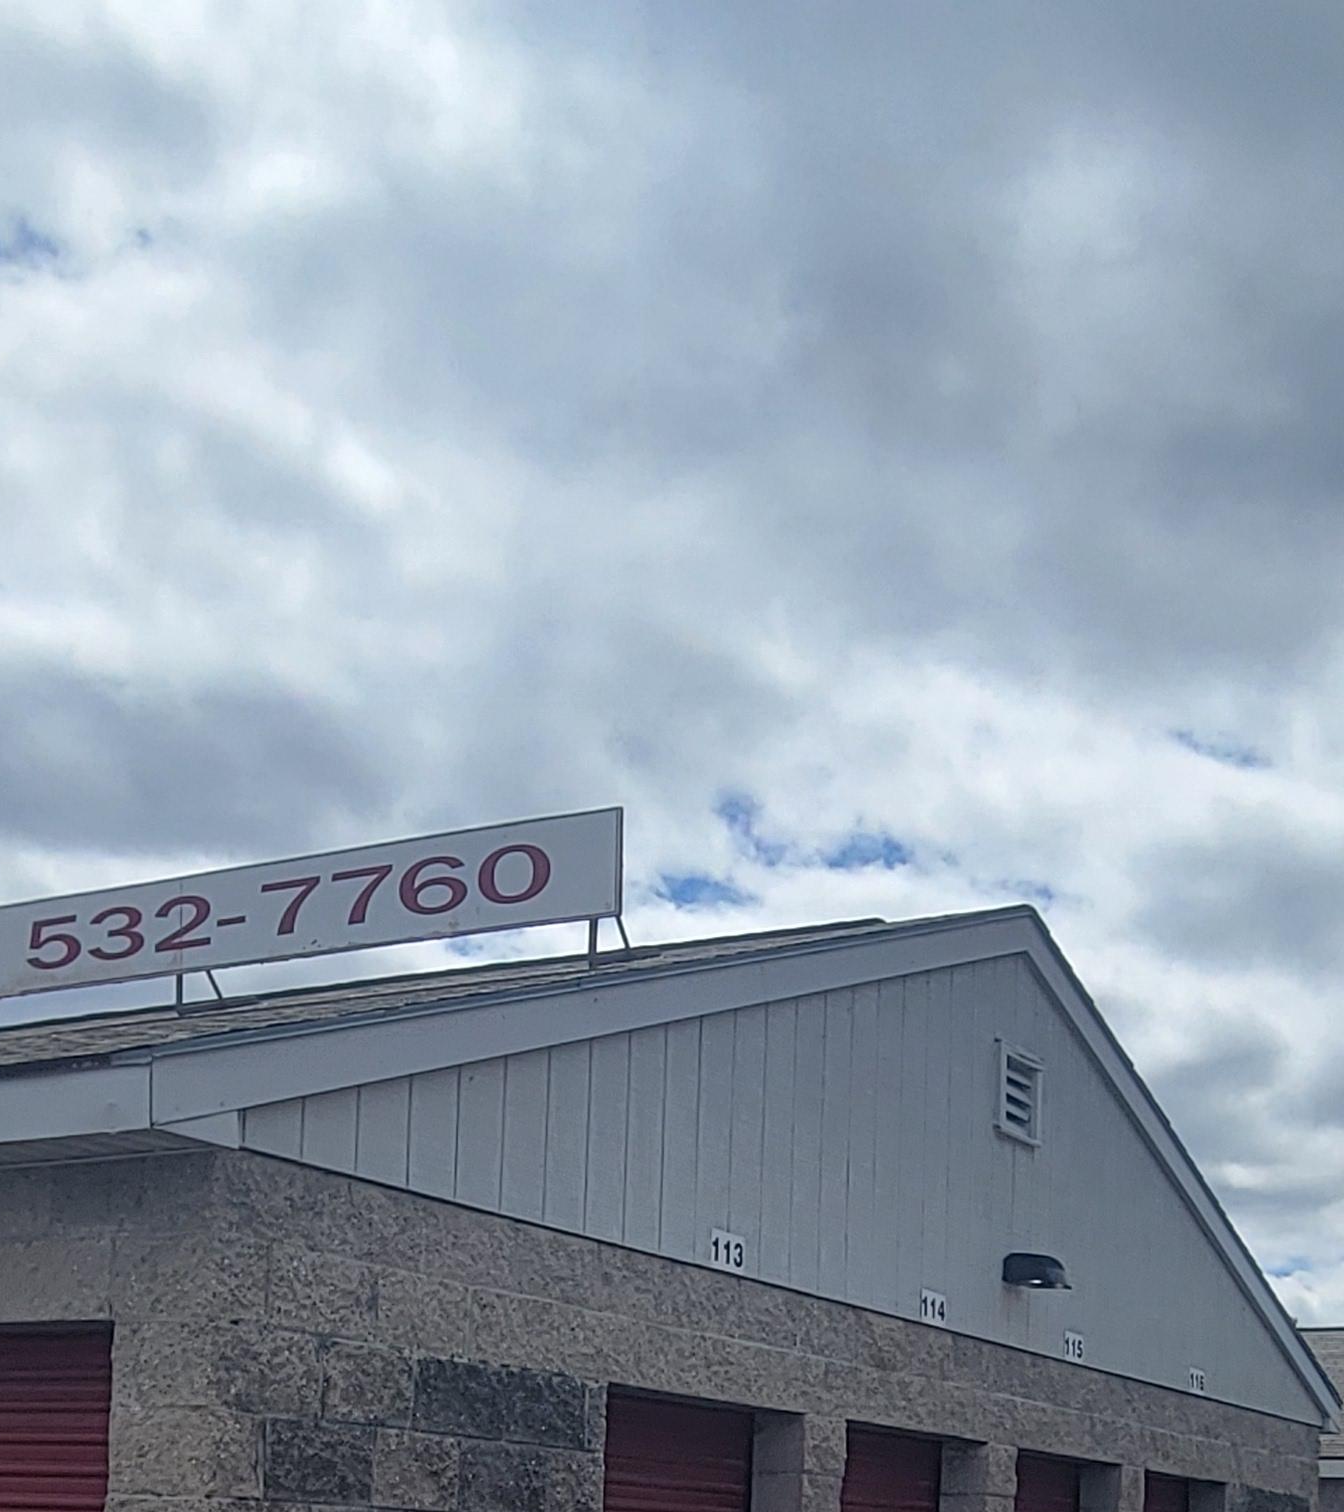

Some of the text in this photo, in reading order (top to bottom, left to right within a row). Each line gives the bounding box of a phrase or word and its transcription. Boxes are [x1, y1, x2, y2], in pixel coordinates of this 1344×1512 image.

[26, 843, 552, 971] 532-7760
[712, 1237, 743, 1268] 113
[921, 1296, 945, 1321] 114
[1065, 1336, 1083, 1359] 115
